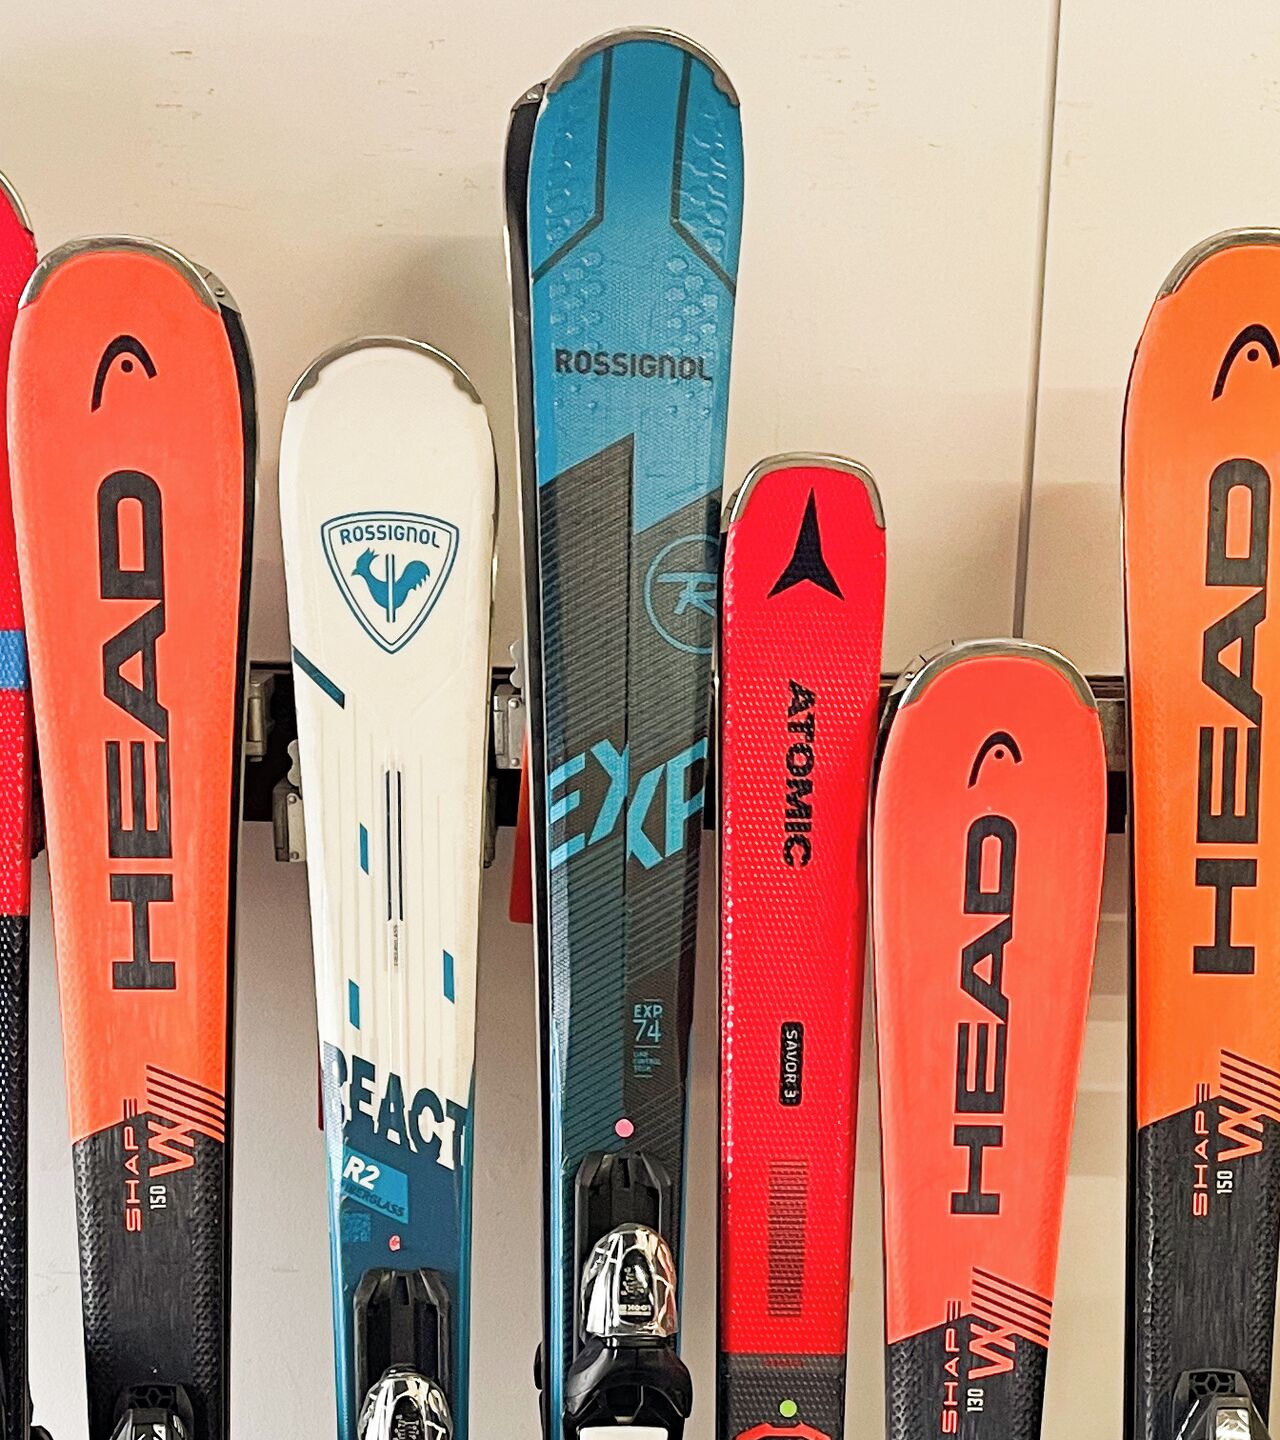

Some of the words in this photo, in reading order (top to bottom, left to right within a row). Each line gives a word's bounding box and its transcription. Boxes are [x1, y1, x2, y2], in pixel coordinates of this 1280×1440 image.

[554, 348, 714, 381] ROSSIGNOL
[340, 526, 441, 549] ROSSIGNOL
[97, 470, 177, 990] HEAD
[1192, 458, 1271, 975] HEAD
[783, 679, 817, 868] ATOMIC
[632, 1020, 662, 1043] 74
[633, 1004, 663, 1019] EXP
[950, 814, 1017, 1215] HEAD
[785, 1029, 798, 1086] SAVOR
[323, 1041, 469, 1171] REACT
[785, 1087, 797, 1099] 3
[123, 1098, 143, 1233] SHAPE
[341, 1153, 381, 1191] R2
[1192, 1083, 1210, 1217] SHAPE
[149, 1185, 168, 1210] 150
[1216, 1170, 1234, 1195] 150
[940, 1300, 962, 1435] SHAPE
[967, 1387, 984, 1413] 130
